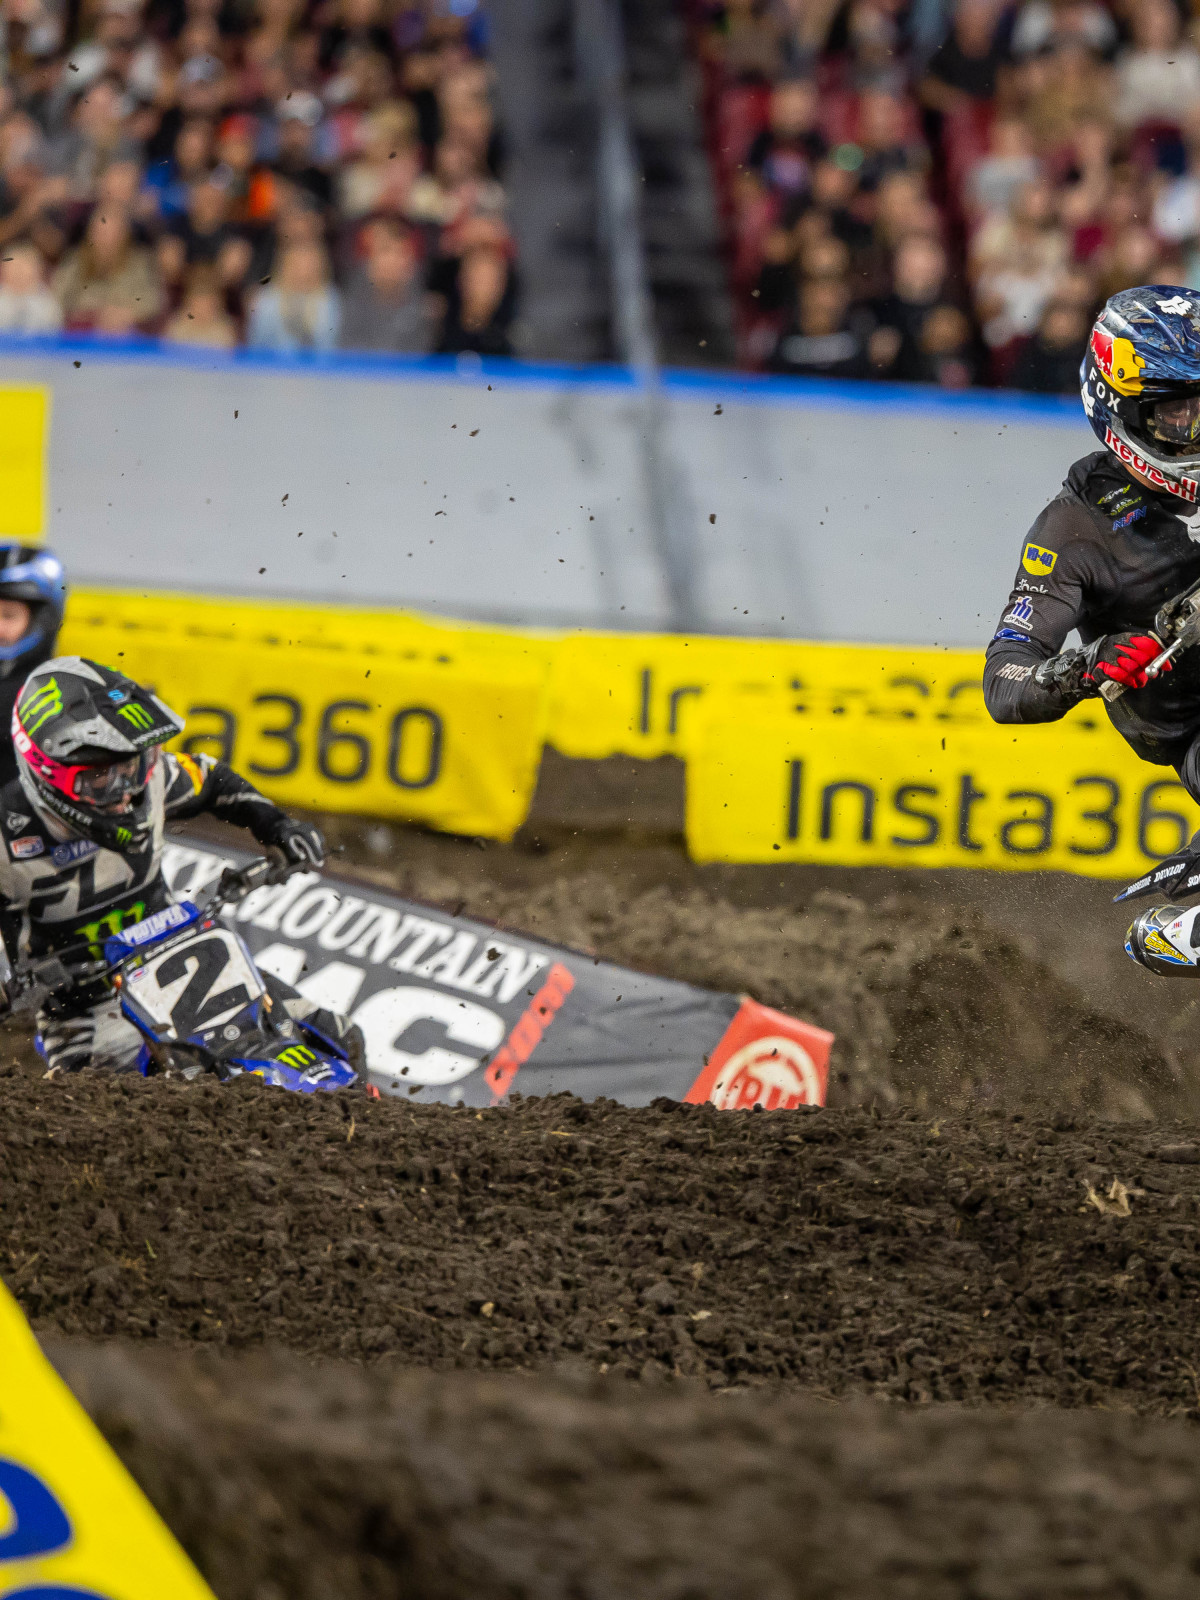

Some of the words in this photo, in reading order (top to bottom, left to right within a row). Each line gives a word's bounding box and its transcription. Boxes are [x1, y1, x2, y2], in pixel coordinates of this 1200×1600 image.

[1089, 366, 1121, 413] FOX
[183, 691, 449, 791] a360
[783, 757, 1190, 862] Insta36
[1153, 863, 1187, 883] DUNLOP
[155, 936, 252, 1037] 2
[223, 871, 549, 1004] MOUNTAIN
